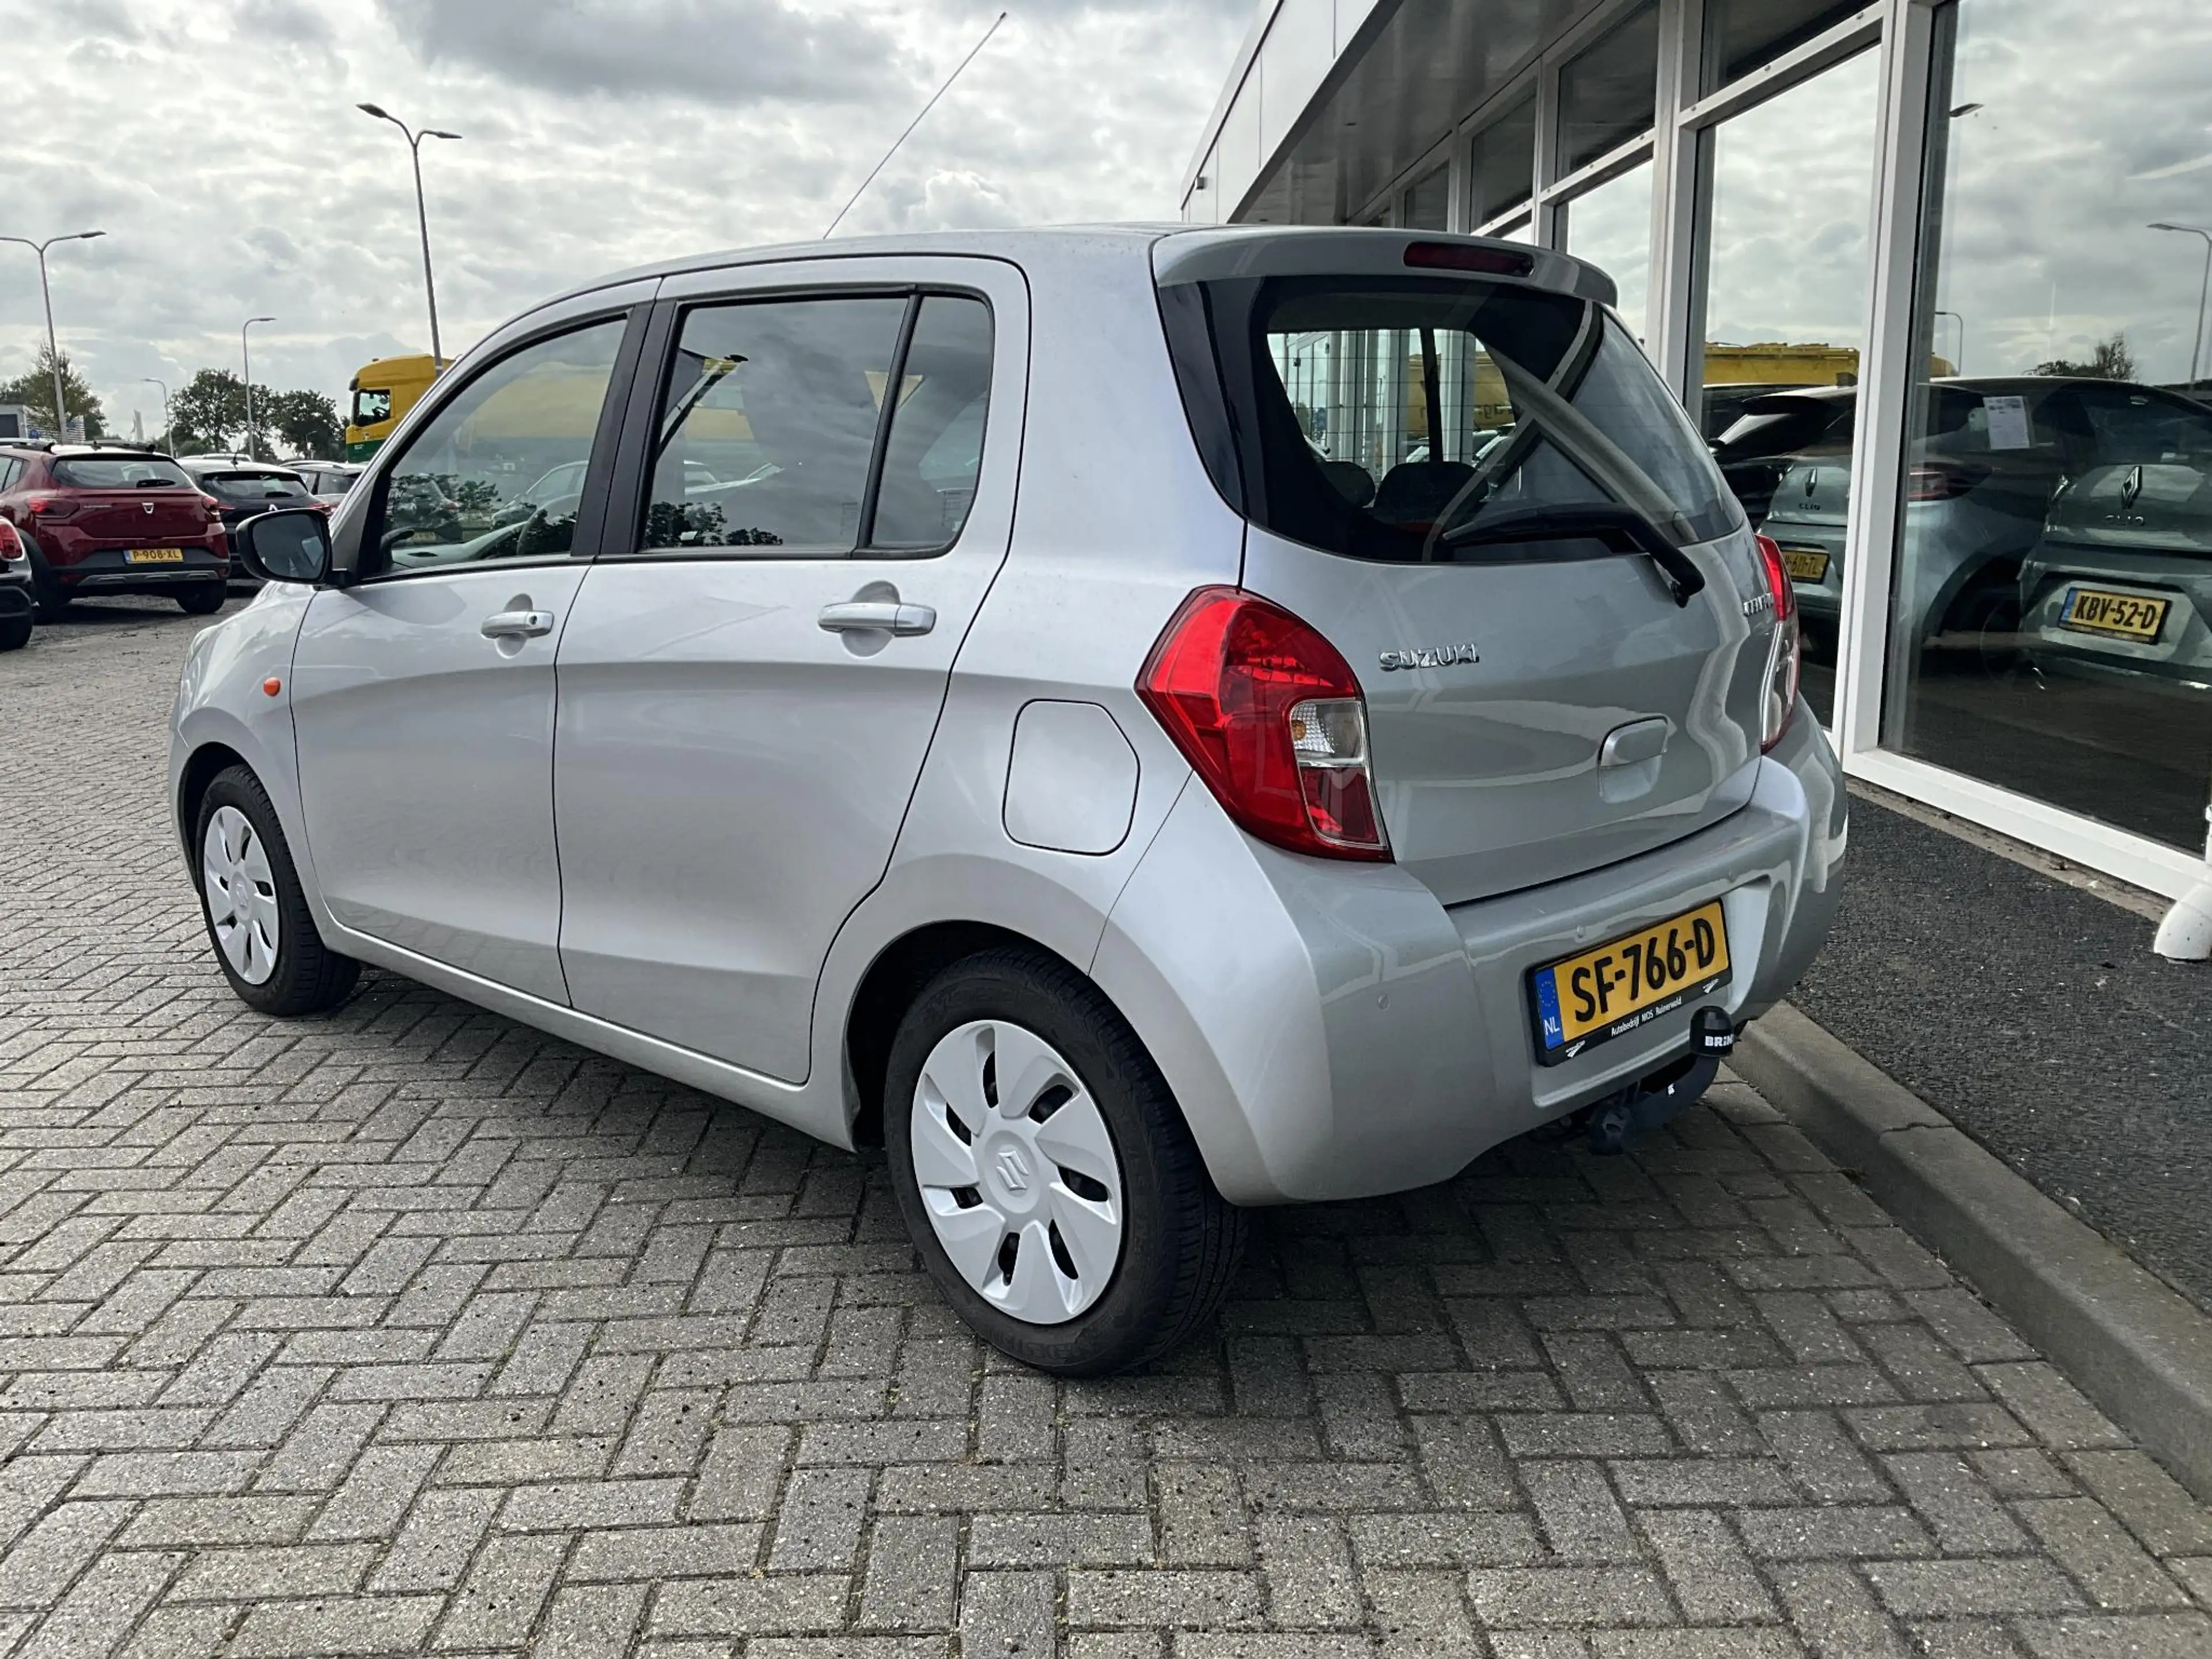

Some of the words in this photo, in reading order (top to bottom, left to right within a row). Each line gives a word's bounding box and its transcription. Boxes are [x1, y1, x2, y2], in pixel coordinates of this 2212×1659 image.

[132, 550, 180, 560] P-908-XL
[2075, 594, 2157, 629] KBV-52-D
[1378, 643, 1479, 672] SUZUKI
[1544, 1016, 1560, 1036] NL
[1571, 918, 1715, 1022] SF-766-D
